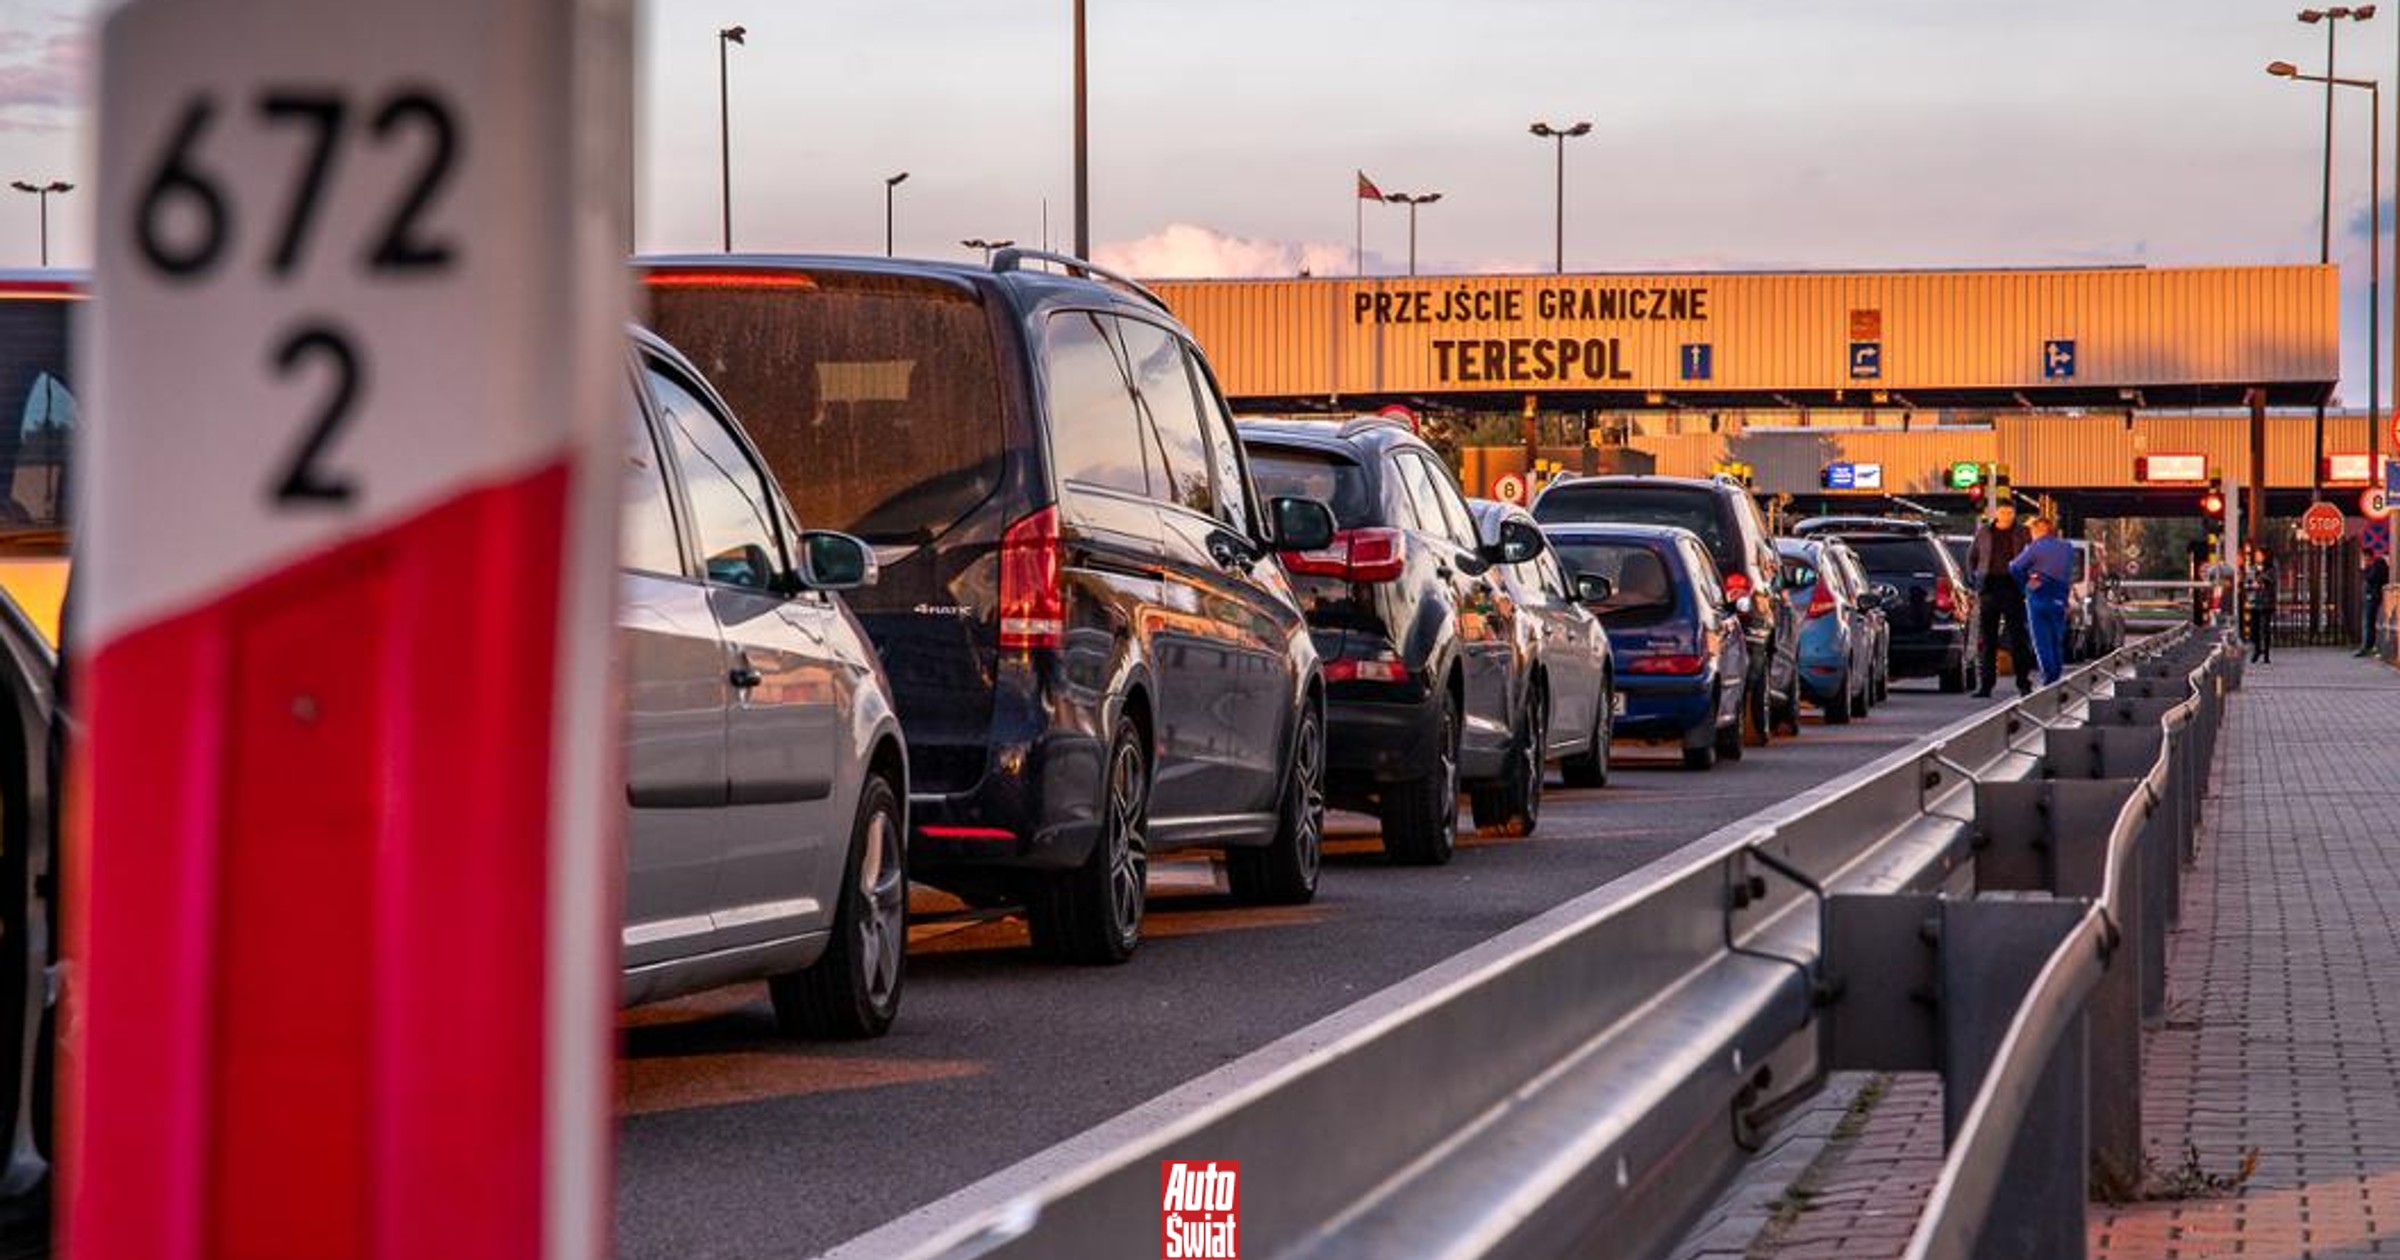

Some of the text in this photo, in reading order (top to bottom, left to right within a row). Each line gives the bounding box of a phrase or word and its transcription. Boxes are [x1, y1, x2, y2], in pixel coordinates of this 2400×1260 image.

[136, 86, 460, 280] 672
[1355, 284, 1708, 323] PRZEJŚCIE GRANICZNE
[1433, 338, 1632, 382] TERESPOL
[269, 321, 367, 509] 2
[2309, 517, 2340, 530] STOP
